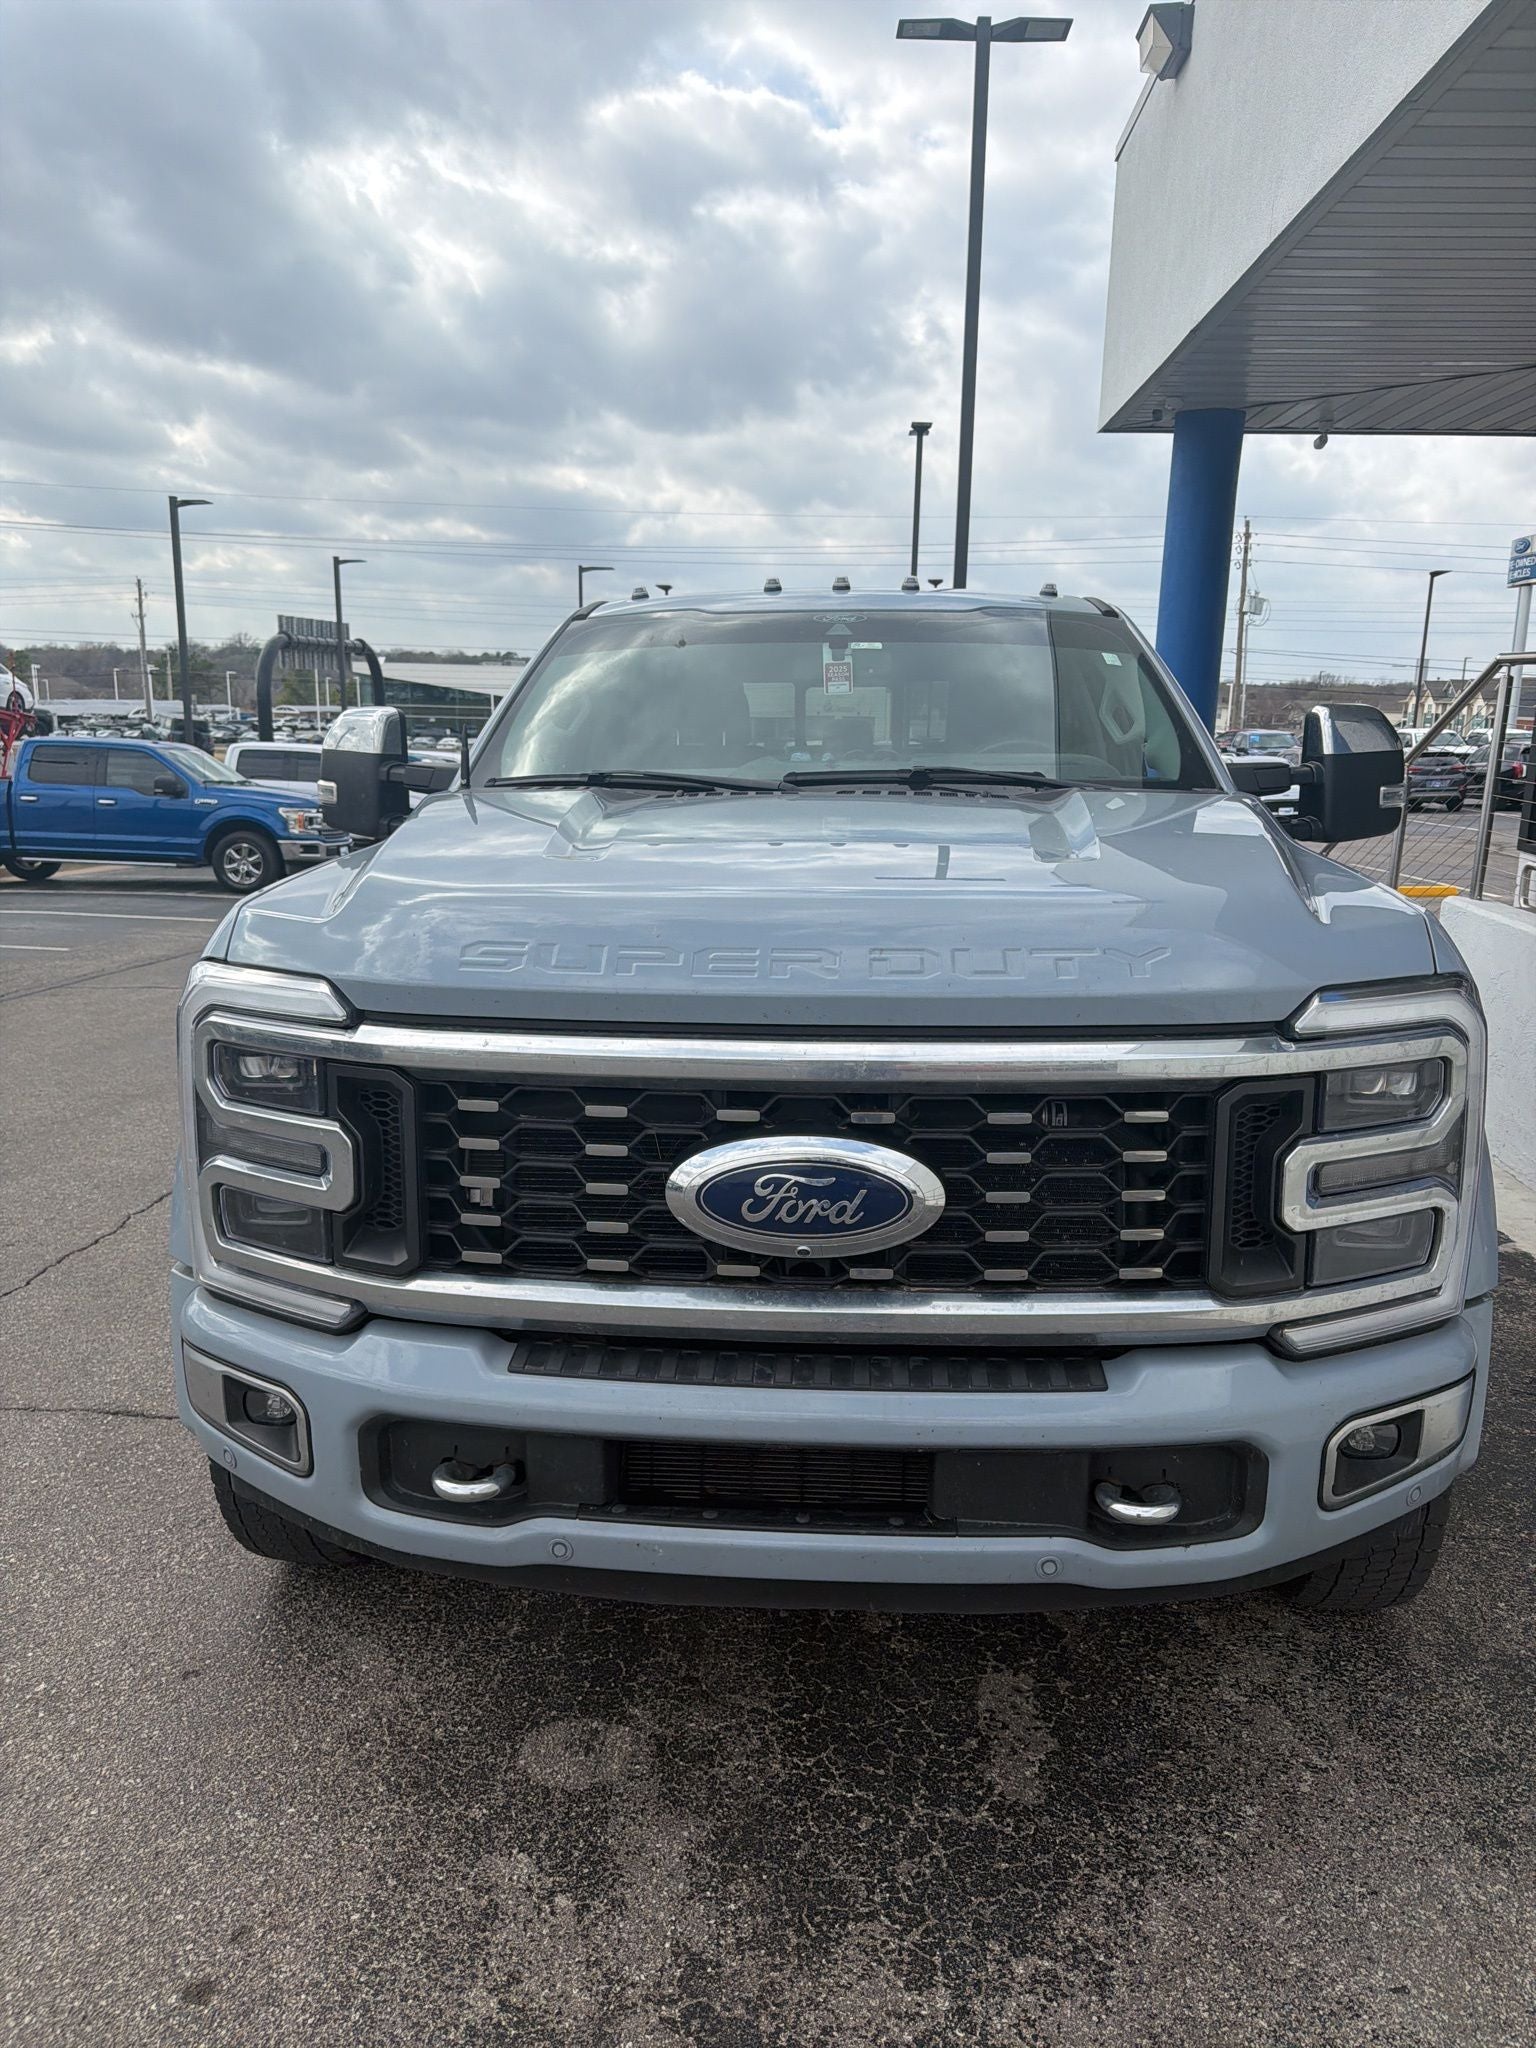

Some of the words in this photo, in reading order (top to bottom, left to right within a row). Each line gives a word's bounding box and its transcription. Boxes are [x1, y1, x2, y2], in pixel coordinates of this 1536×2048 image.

[458, 939, 842, 979] SUPER
[868, 947, 1172, 979] DUTY
[741, 1173, 867, 1225] Ford
